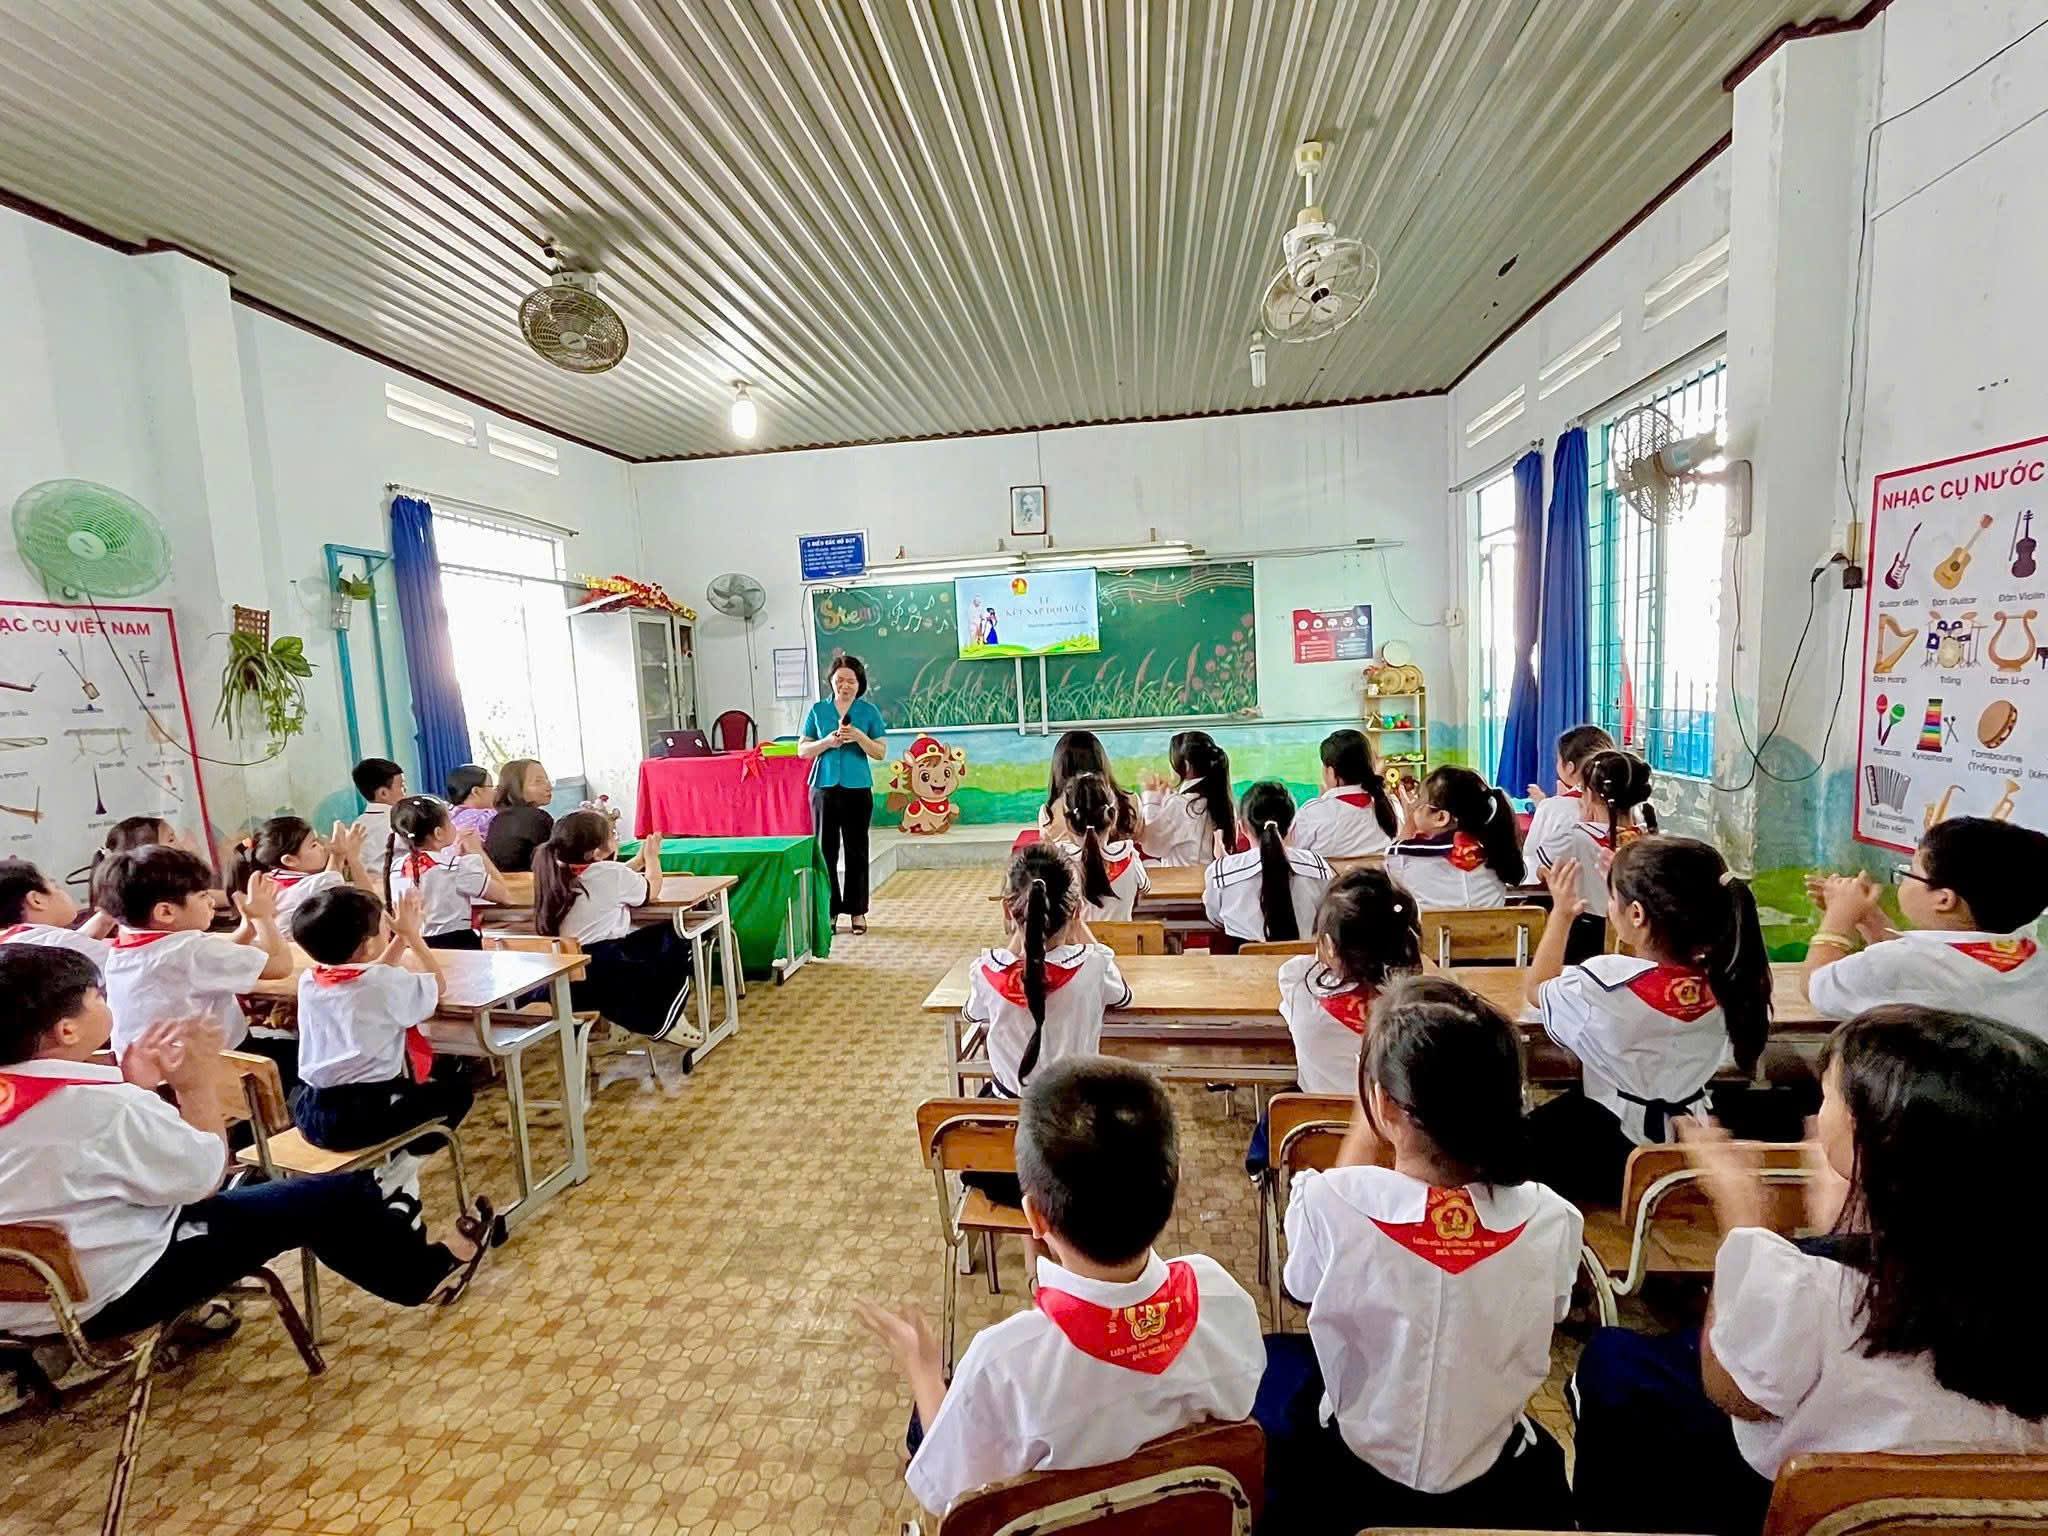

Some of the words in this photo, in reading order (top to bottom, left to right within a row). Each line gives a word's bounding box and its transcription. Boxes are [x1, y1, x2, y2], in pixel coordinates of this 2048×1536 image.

[1882, 484, 1935, 511] NHẠC
[1940, 476, 1969, 501] CỤ
[1974, 459, 2045, 493] NƯỚC
[32, 618, 61, 636] CỤ
[111, 621, 151, 636] NAM
